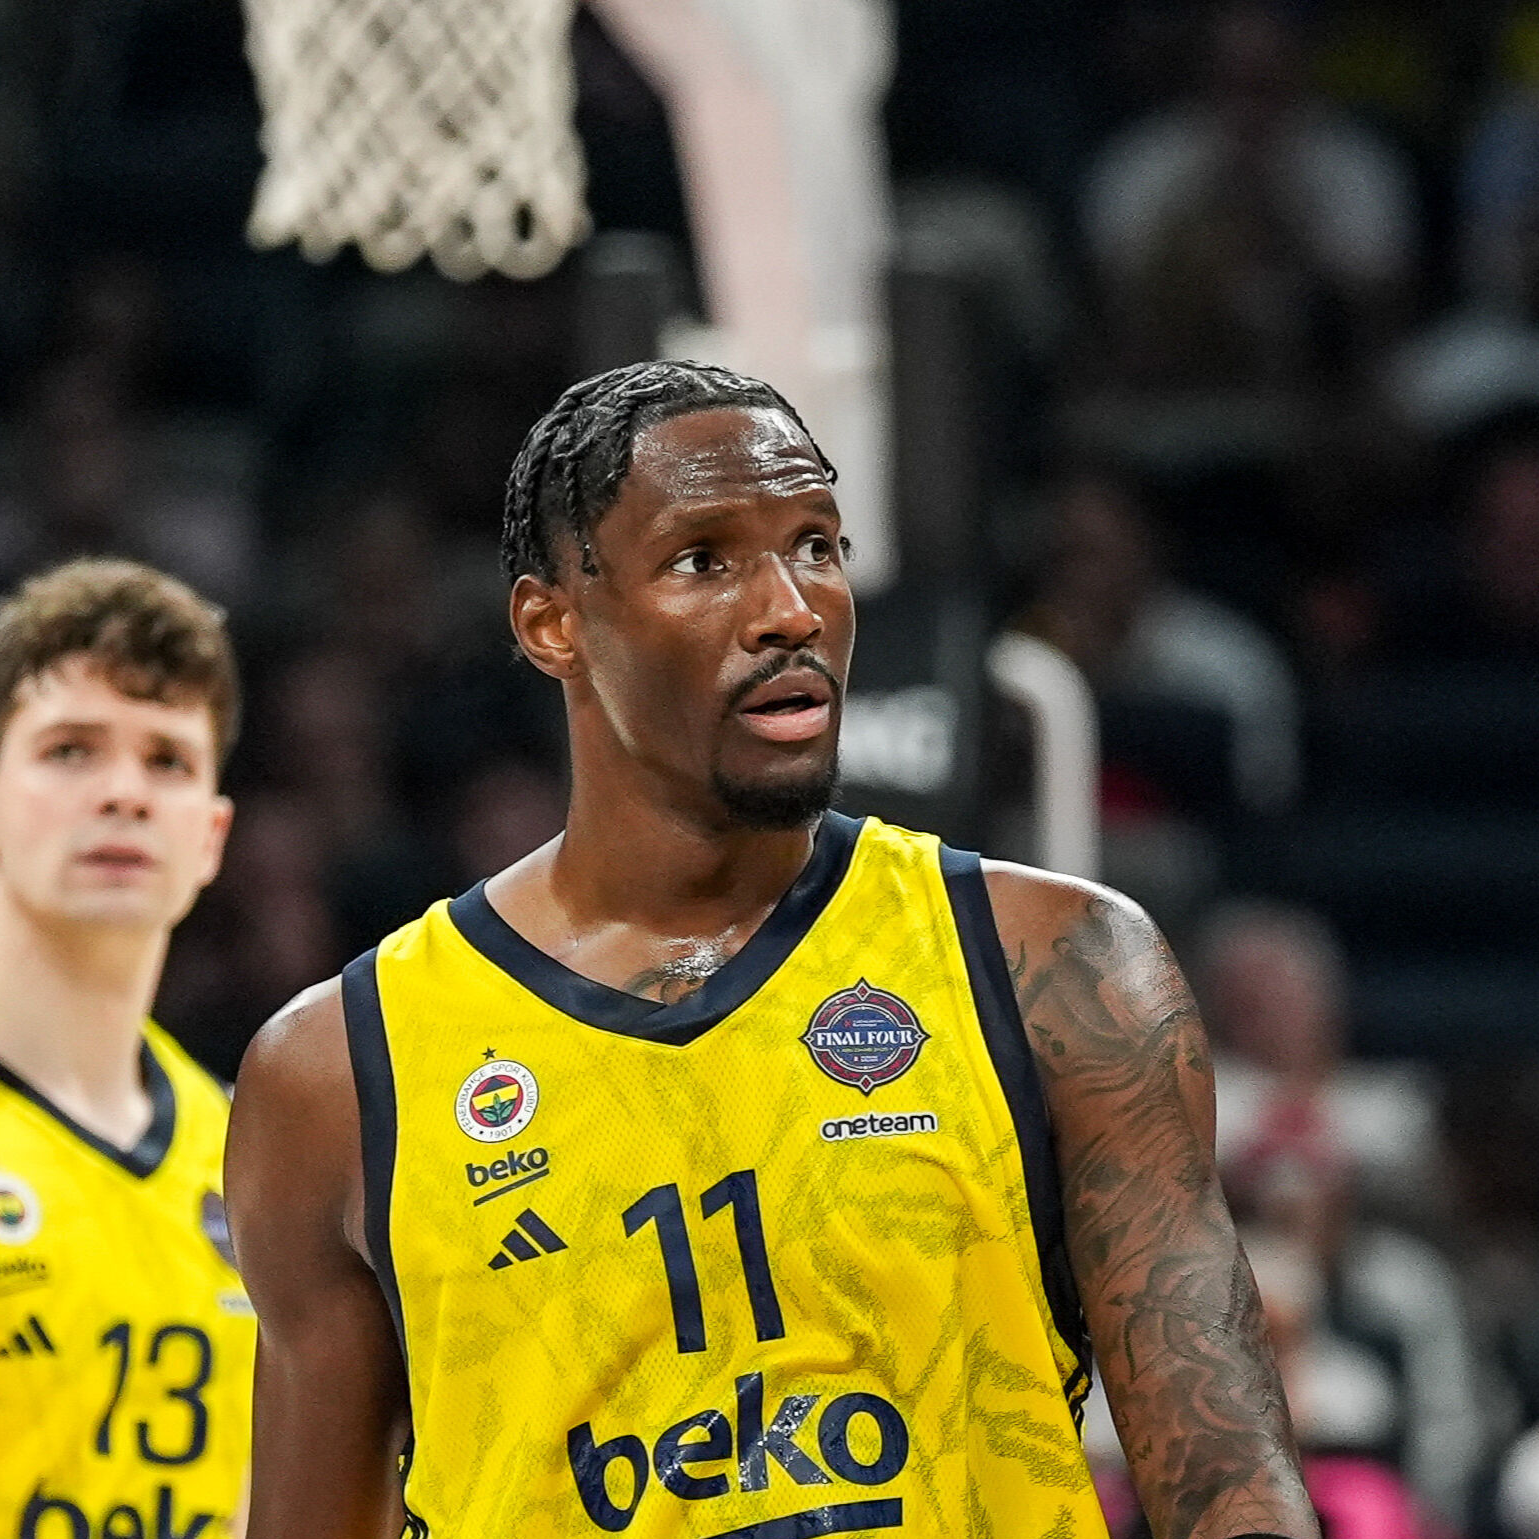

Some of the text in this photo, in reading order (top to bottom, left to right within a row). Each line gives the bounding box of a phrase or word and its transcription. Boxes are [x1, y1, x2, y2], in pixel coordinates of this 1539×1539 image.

[816, 1030, 914, 1046] FINAL FOUR
[465, 1147, 550, 1187] beko
[822, 1113, 936, 1139] oneteam
[621, 1168, 787, 1354] 11
[95, 1322, 213, 1466] 13
[566, 1371, 910, 1533] beko
